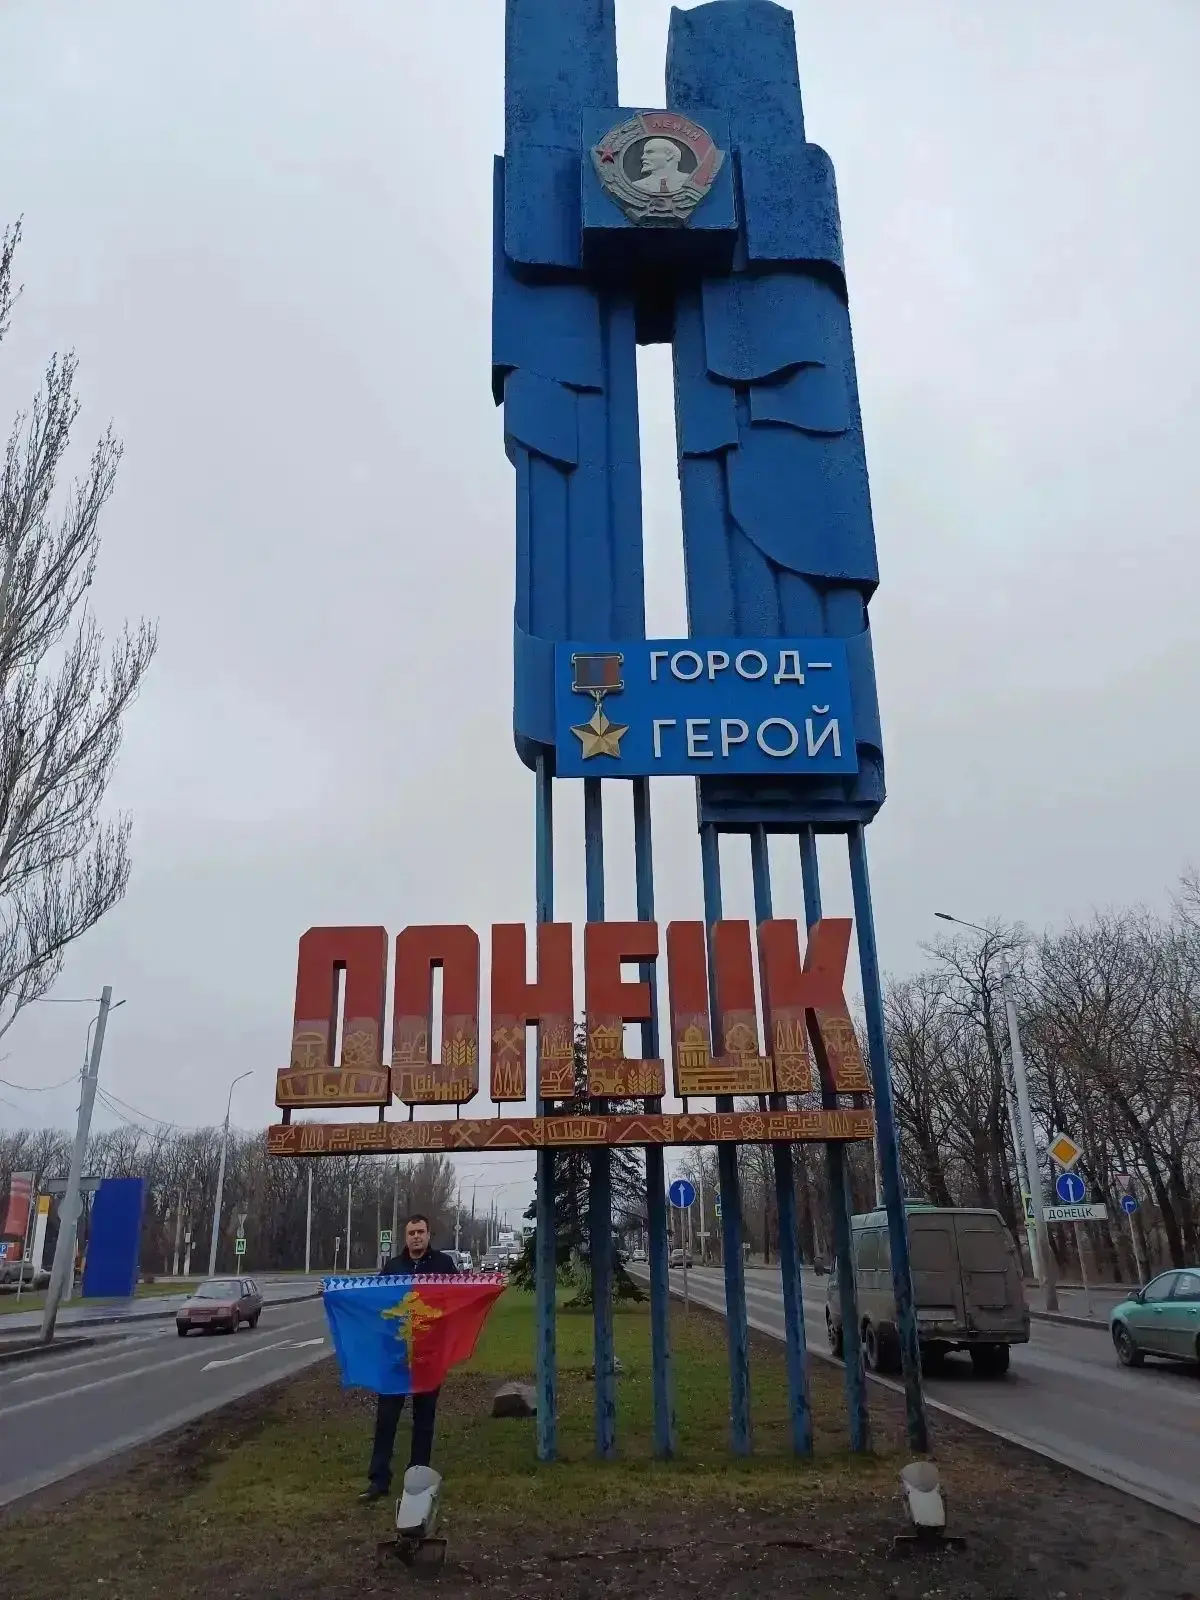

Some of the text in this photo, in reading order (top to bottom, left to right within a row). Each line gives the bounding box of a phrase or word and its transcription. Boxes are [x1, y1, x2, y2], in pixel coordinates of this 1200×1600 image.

[652, 119, 701, 141] ЛЕНИН
[650, 650, 832, 685] ГОРОД-
[653, 704, 842, 758] ГЕРОЙ
[275, 918, 871, 1108] ДОНЕЦК
[1049, 1208, 1094, 1219] ДОНЕЦК
